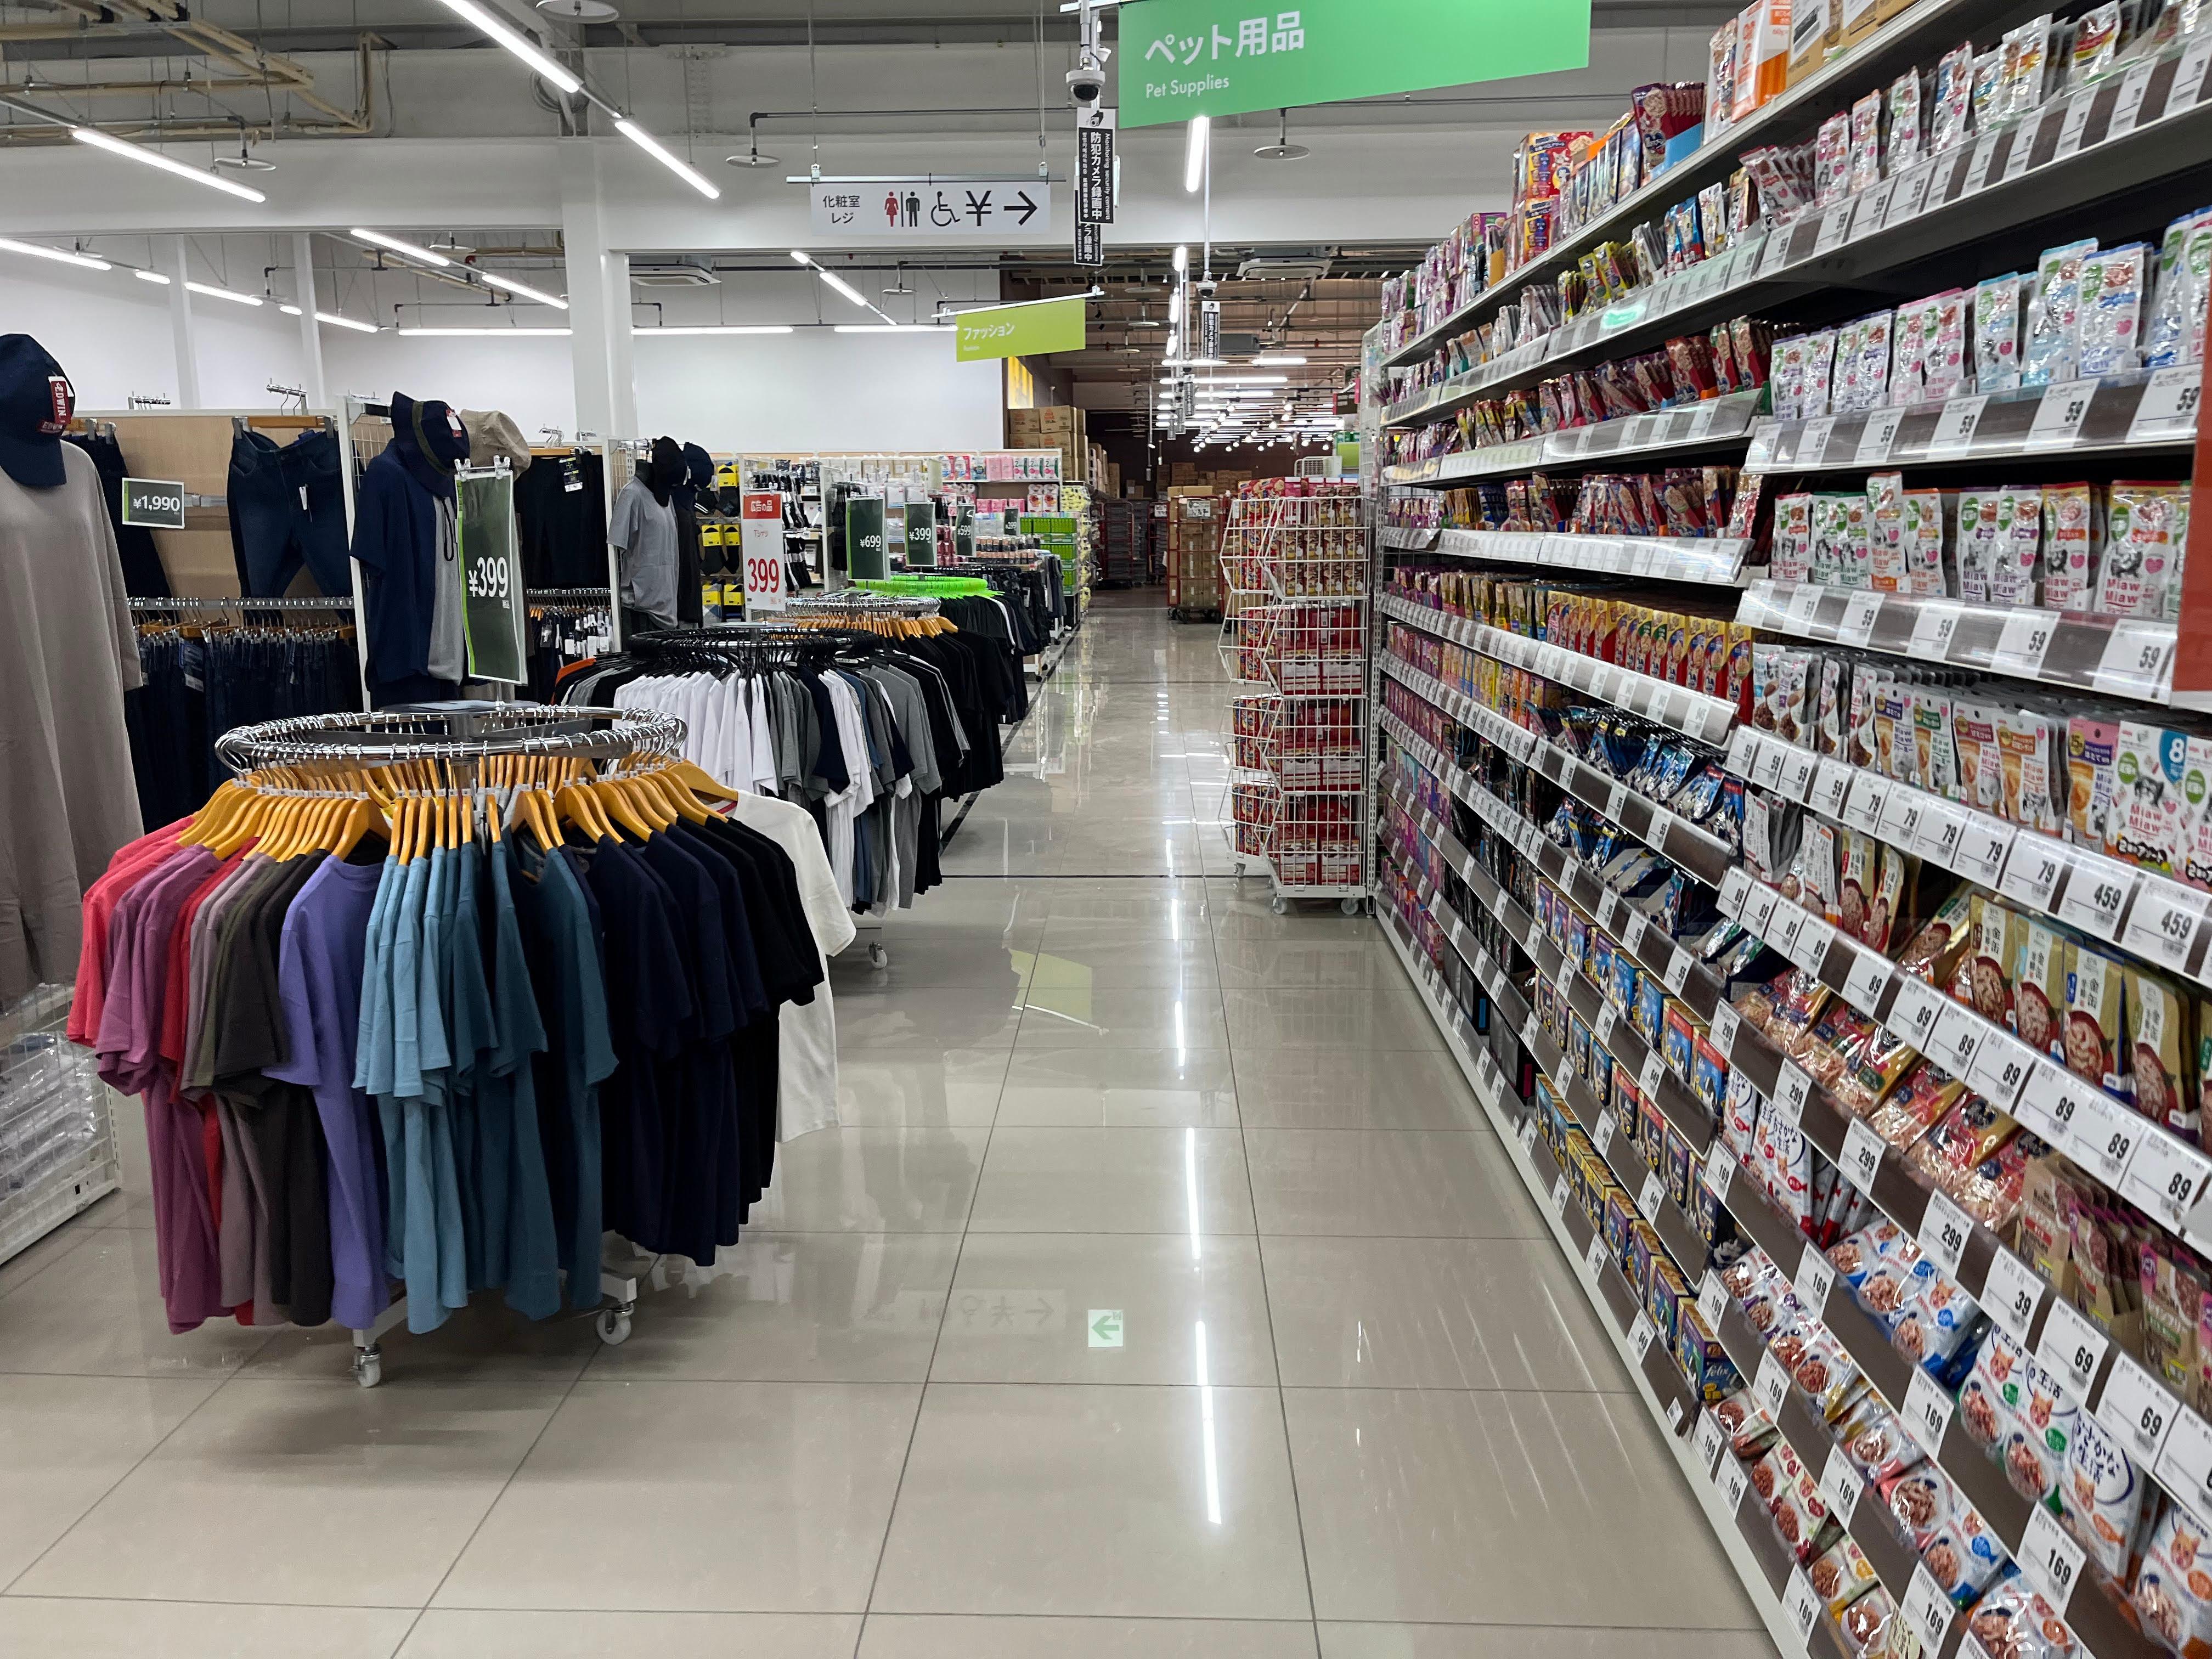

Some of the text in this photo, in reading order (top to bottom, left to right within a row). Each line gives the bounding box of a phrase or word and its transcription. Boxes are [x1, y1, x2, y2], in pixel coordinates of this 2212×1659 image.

[1144, 10, 1305, 66] ペット用品
[1146, 74, 1229, 98] Pet Supplies
[1090, 132, 1102, 219] 防犯カメラ録画中
[822, 195, 861, 208] 化粧室
[831, 212, 854, 224] レジ
[963, 323, 1015, 341] ファッション
[2176, 387, 2200, 411] 59
[2065, 400, 2084, 422] 59
[133, 495, 180, 511] ¥1,990
[860, 535, 881, 548] ¥699
[909, 527, 932, 540] ¥399
[469, 557, 509, 597] ¥399
[748, 558, 780, 593] 399
[2106, 578, 2140, 591] Miaw
[2105, 590, 2138, 603] Miaw
[1938, 619, 1953, 638] 59
[2029, 630, 2046, 651] 59
[2139, 646, 2161, 668] 59
[2169, 737, 2185, 764] 8
[1771, 755, 1781, 771] 59
[1798, 766, 1808, 783] 59
[1832, 780, 1844, 797] 59
[1869, 794, 1881, 812] 79
[2131, 804, 2163, 821] Miaw
[1904, 808, 1918, 827] 79
[2129, 815, 2160, 833] Miaw
[1943, 825, 1957, 844] 79
[1987, 841, 2002, 862] 79
[2039, 860, 2056, 883] 79
[1735, 888, 1745, 905] 89
[2094, 883, 2121, 910] 459
[1759, 904, 1770, 920] 89
[1786, 920, 1797, 937] 89
[2161, 909, 2192, 939] 459
[1814, 939, 1826, 957] 89
[1869, 974, 1882, 994] 89
[1917, 1006, 1932, 1027] 89
[1722, 1023, 1733, 1041] 299
[1958, 1035, 1974, 1056] 89
[2002, 1062, 2021, 1086] 89
[1790, 1084, 1803, 1105] 299
[2056, 1097, 2074, 1121] 89
[2108, 1133, 2130, 1159] 89
[1858, 1148, 1876, 1171] 299
[1719, 1164, 1730, 1183] 169
[2168, 1172, 2193, 1201] 89
[1941, 1224, 1962, 1251] 299
[1812, 1273, 1827, 1297] 169
[1711, 1295, 1722, 1313] 169
[2015, 1290, 2032, 1316] 39
[2074, 1347, 2094, 1373] 69
[1769, 1379, 1782, 1401] 169
[1925, 1403, 1943, 1432] 169
[2141, 1408, 2163, 1437] 69
[1705, 1435, 1716, 1454] 169
[1729, 1479, 1741, 1498] 169
[1839, 1478, 1855, 1504] 169
[2047, 1549, 2072, 1585] 169
[1798, 1599, 1813, 1624] 169
[1925, 1604, 1944, 1635] 169
